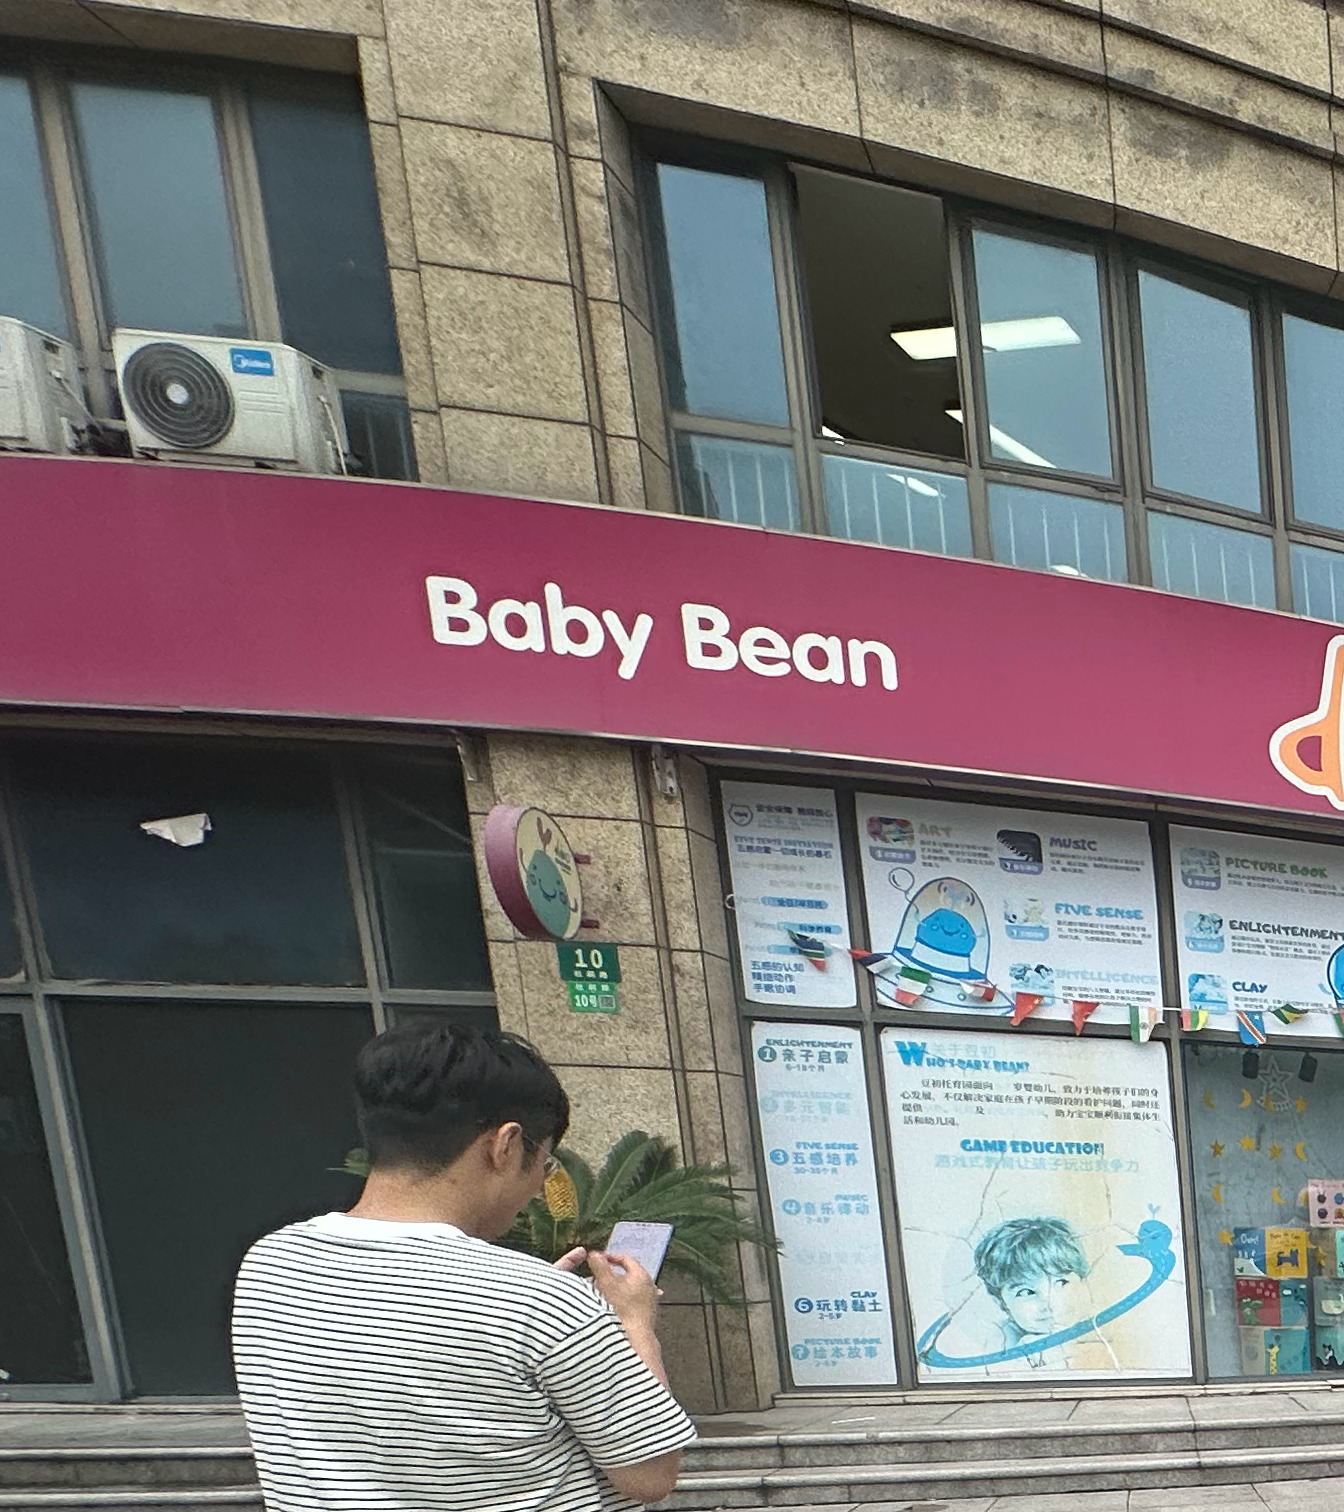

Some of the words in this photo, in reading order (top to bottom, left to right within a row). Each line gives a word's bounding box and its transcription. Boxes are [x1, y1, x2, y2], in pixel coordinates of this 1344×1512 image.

[425, 575, 653, 680] Baby
[681, 602, 898, 690] Bean
[1050, 837, 1098, 851] MUSIC
[1225, 856, 1287, 874] PICTURE
[1290, 863, 1329, 879] BOOK
[1054, 902, 1092, 917] FIVE
[1095, 907, 1144, 920] SENSE
[574, 948, 604, 969] 10
[1232, 980, 1268, 994] CLAY
[782, 1050, 849, 1064] 亲子启蒙
[960, 1138, 1007, 1153] GAME
[1011, 1140, 1105, 1155] EDUCATION
[850, 1291, 877, 1299] CLAY
